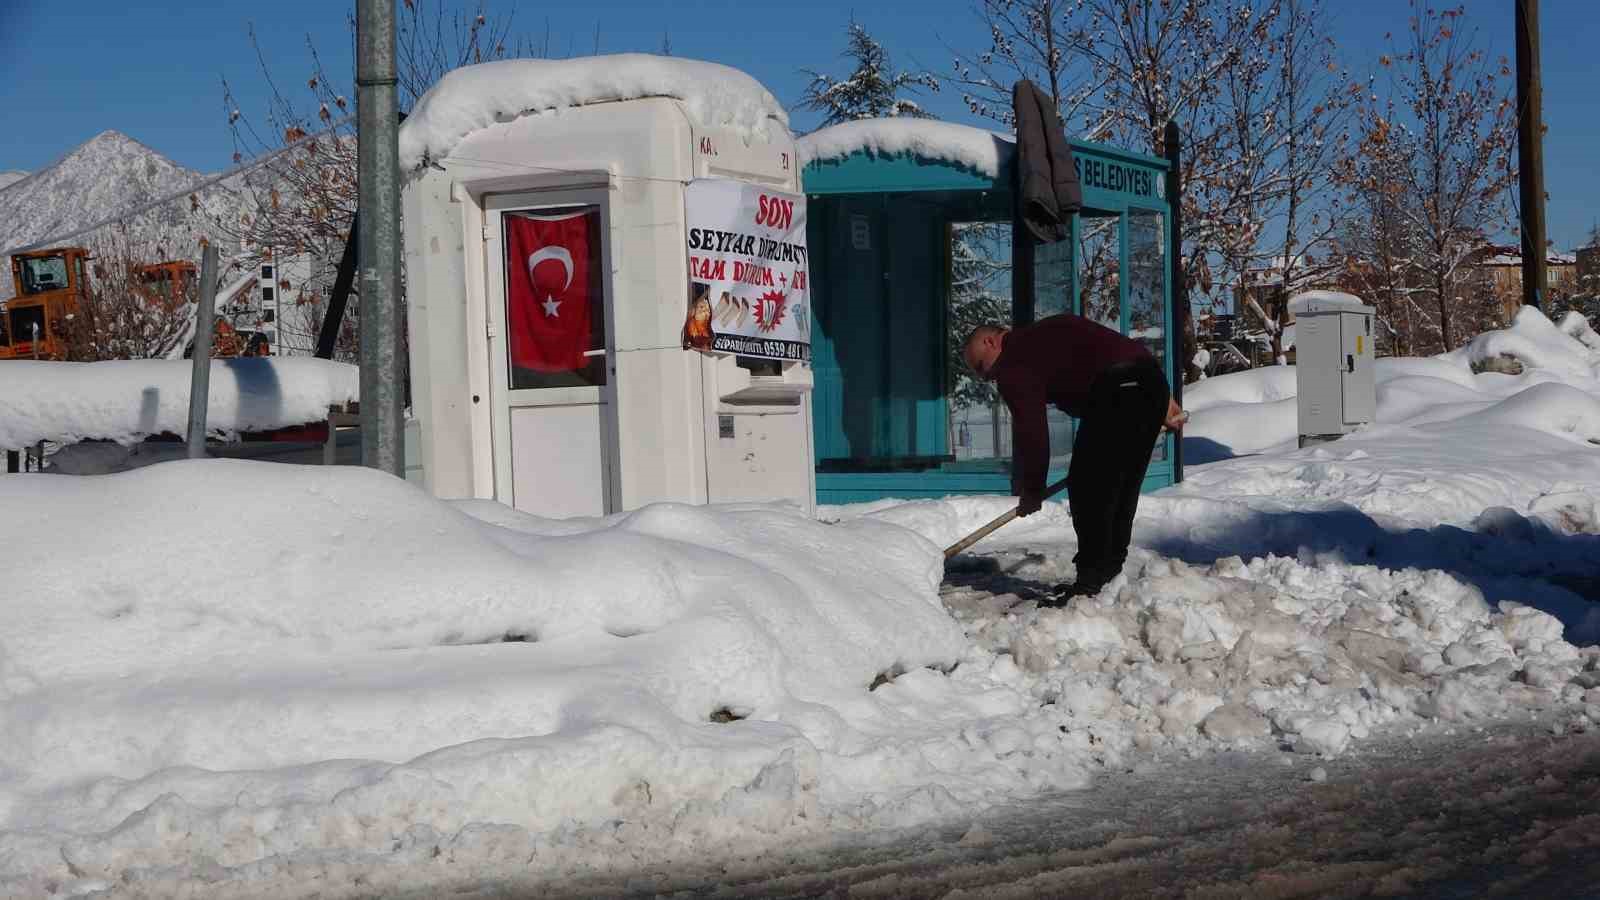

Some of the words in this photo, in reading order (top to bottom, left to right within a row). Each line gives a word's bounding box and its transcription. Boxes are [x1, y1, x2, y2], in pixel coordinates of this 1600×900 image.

[756, 194, 794, 230] SON
[688, 228, 755, 256] SEYYAR
[690, 256, 727, 281] TAM
[764, 341, 786, 357] 0539
